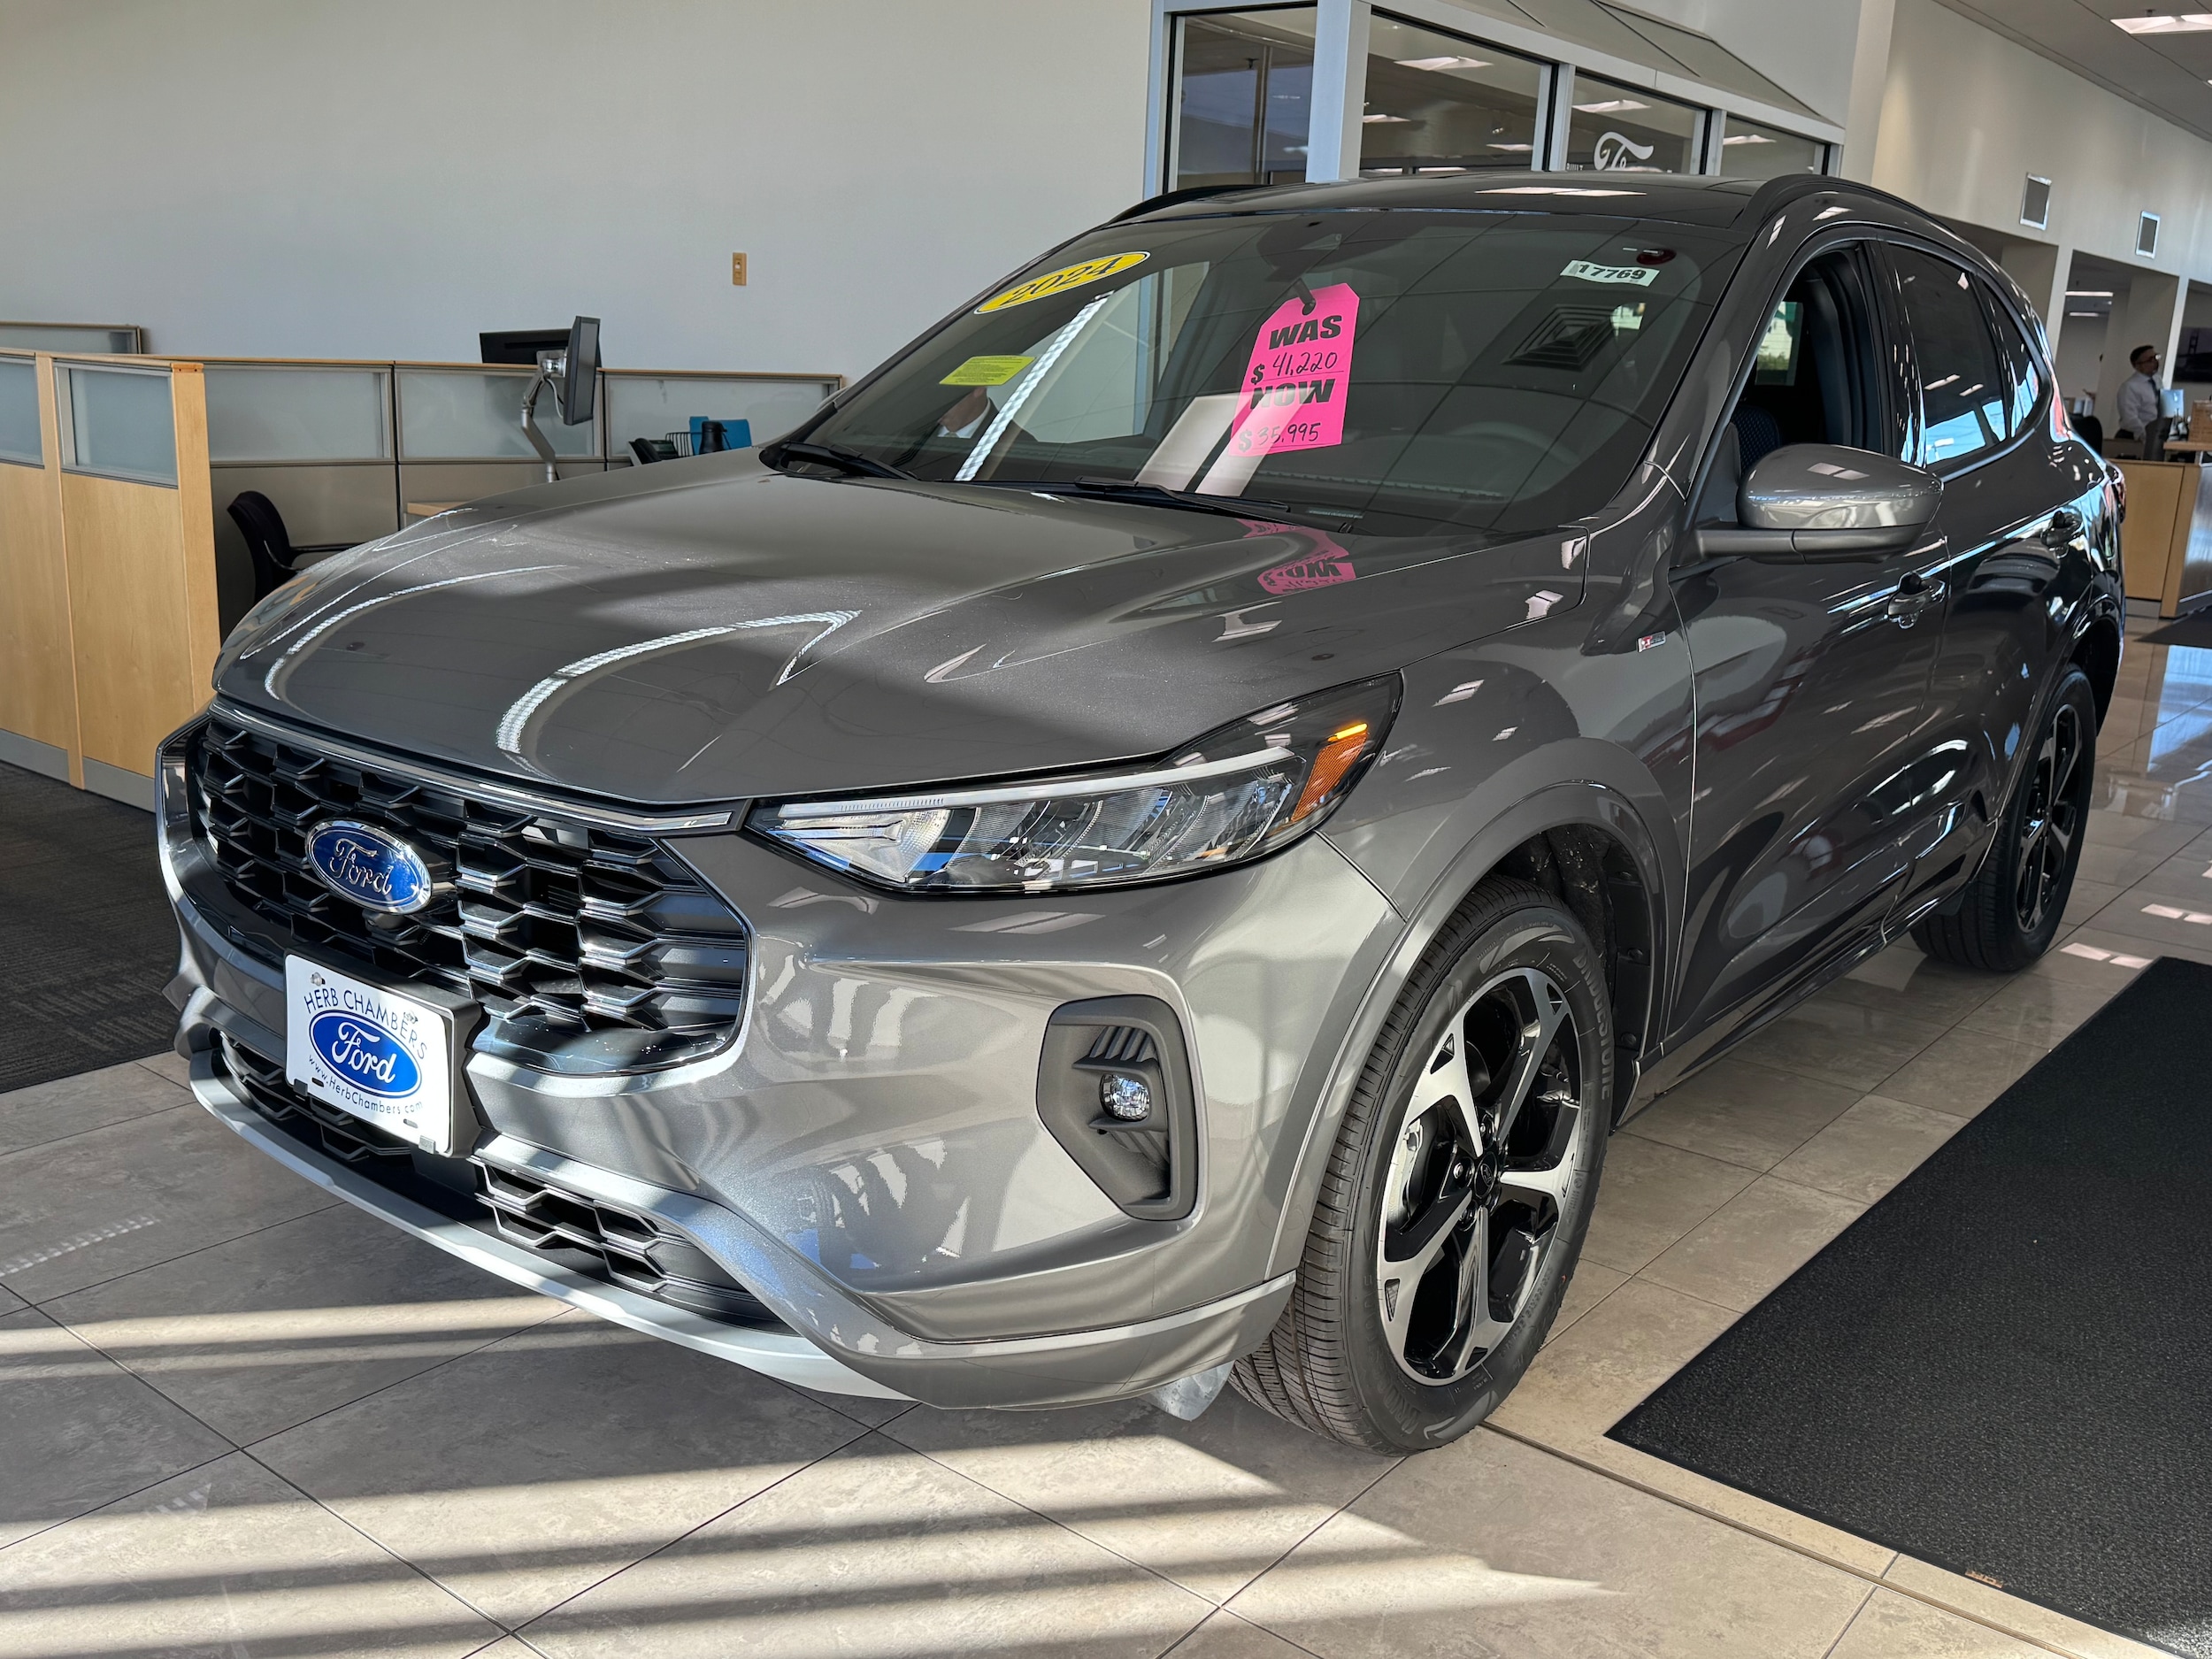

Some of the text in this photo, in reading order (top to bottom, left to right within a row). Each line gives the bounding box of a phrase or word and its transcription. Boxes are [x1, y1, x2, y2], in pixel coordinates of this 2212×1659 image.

[999, 257, 1124, 306] 2024
[1578, 265, 1647, 280] 17769
[1269, 315, 1342, 349] WAS
[1250, 351, 1338, 386] $ 41,220
[1249, 378, 1336, 410] NOW
[1239, 428, 1253, 453] $
[329, 838, 395, 895] Ford
[303, 987, 427, 1060] HERB CHAMBERS
[331, 1021, 397, 1084] Ford
[308, 1054, 424, 1115] www.HerbChamberscom
